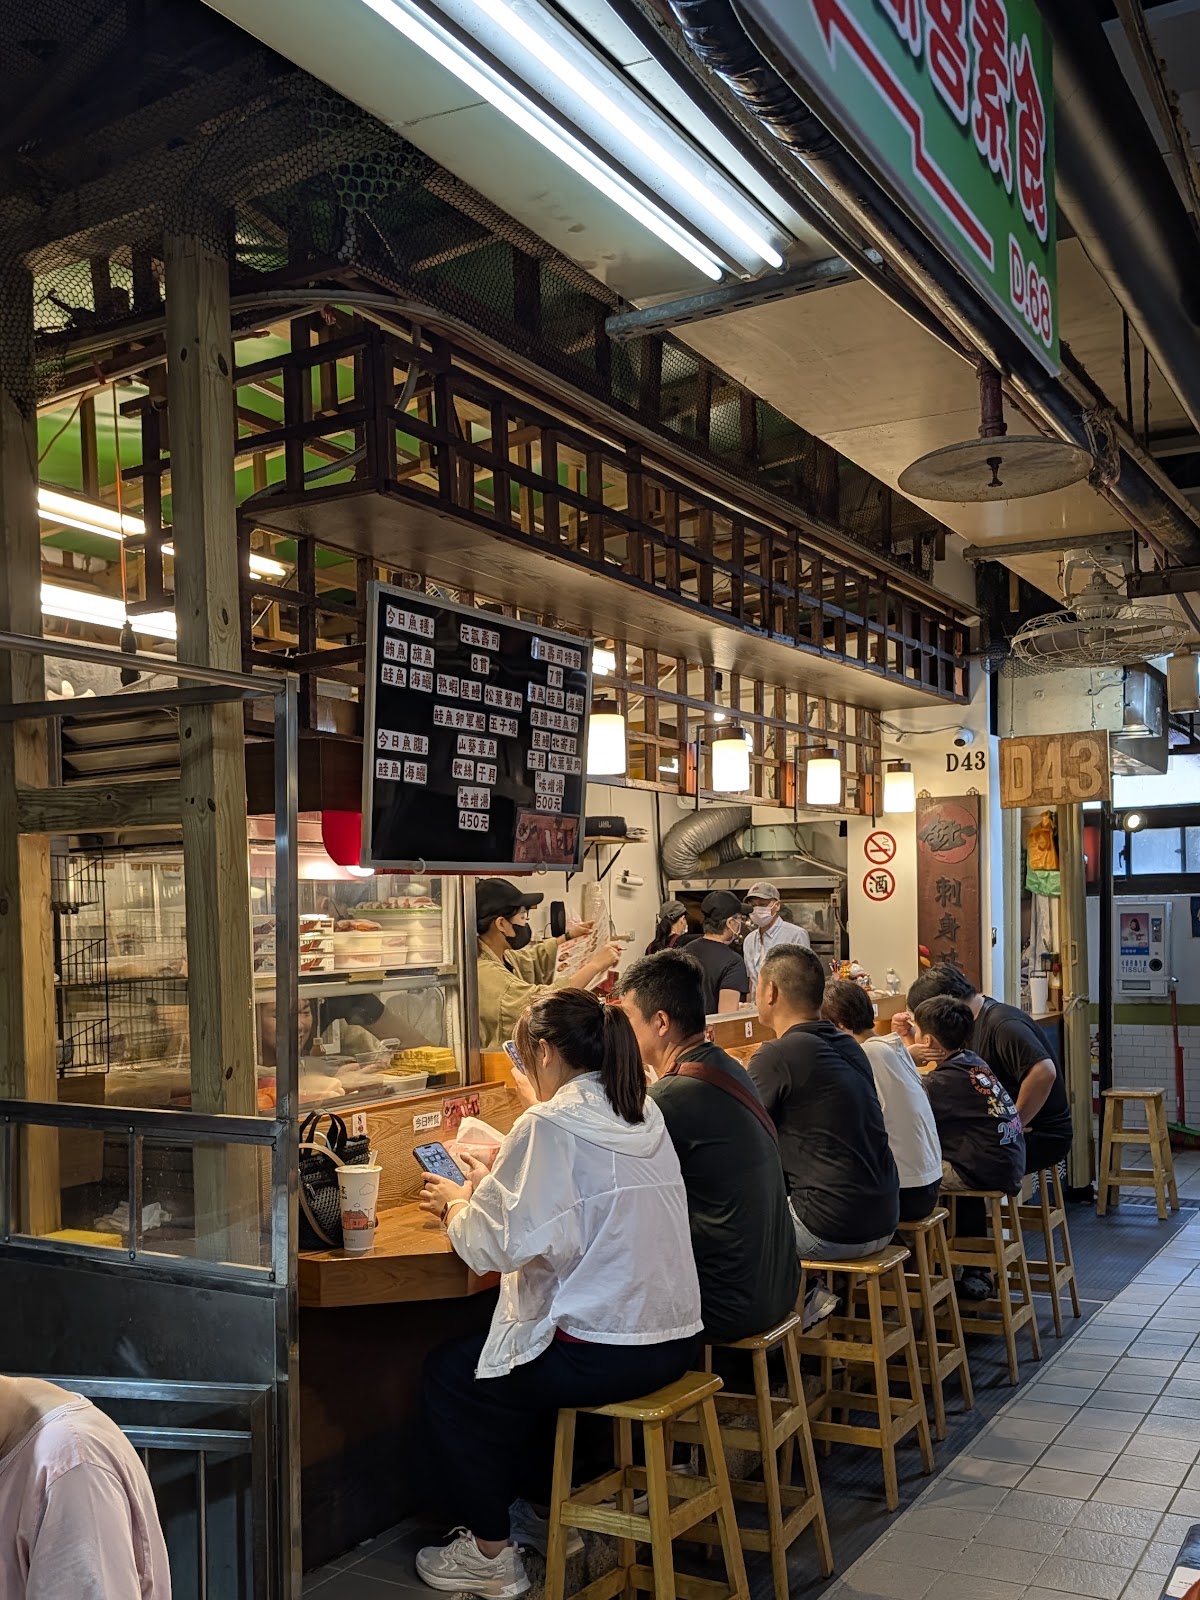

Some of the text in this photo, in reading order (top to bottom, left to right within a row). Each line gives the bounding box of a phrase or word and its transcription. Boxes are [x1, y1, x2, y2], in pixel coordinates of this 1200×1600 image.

[461, 626, 499, 648] 元氣壽司
[385, 641, 432, 665] 鮪魚 旗魚
[472, 657, 488, 673] 8貫
[383, 667, 405, 685] 鮭魚
[549, 670, 562, 685] 7貫
[462, 682, 481, 699] 星鰻
[486, 688, 521, 708] 松葉蟹肉
[547, 692, 563, 706] 鮭魚
[435, 709, 485, 729] 鮭魚卵軍艦
[458, 738, 496, 756] 山葵章魚
[552, 737, 575, 752] 北寄貝
[529, 752, 544, 767] 干貝
[945, 751, 986, 772] D43
[378, 762, 400, 778] 鮭魚
[453, 761, 495, 782] 軟絲 干貝
[1002, 738, 1102, 802] D43
[536, 795, 560, 810] 500元
[460, 813, 488, 829] 450元
[869, 874, 888, 894] 酒
